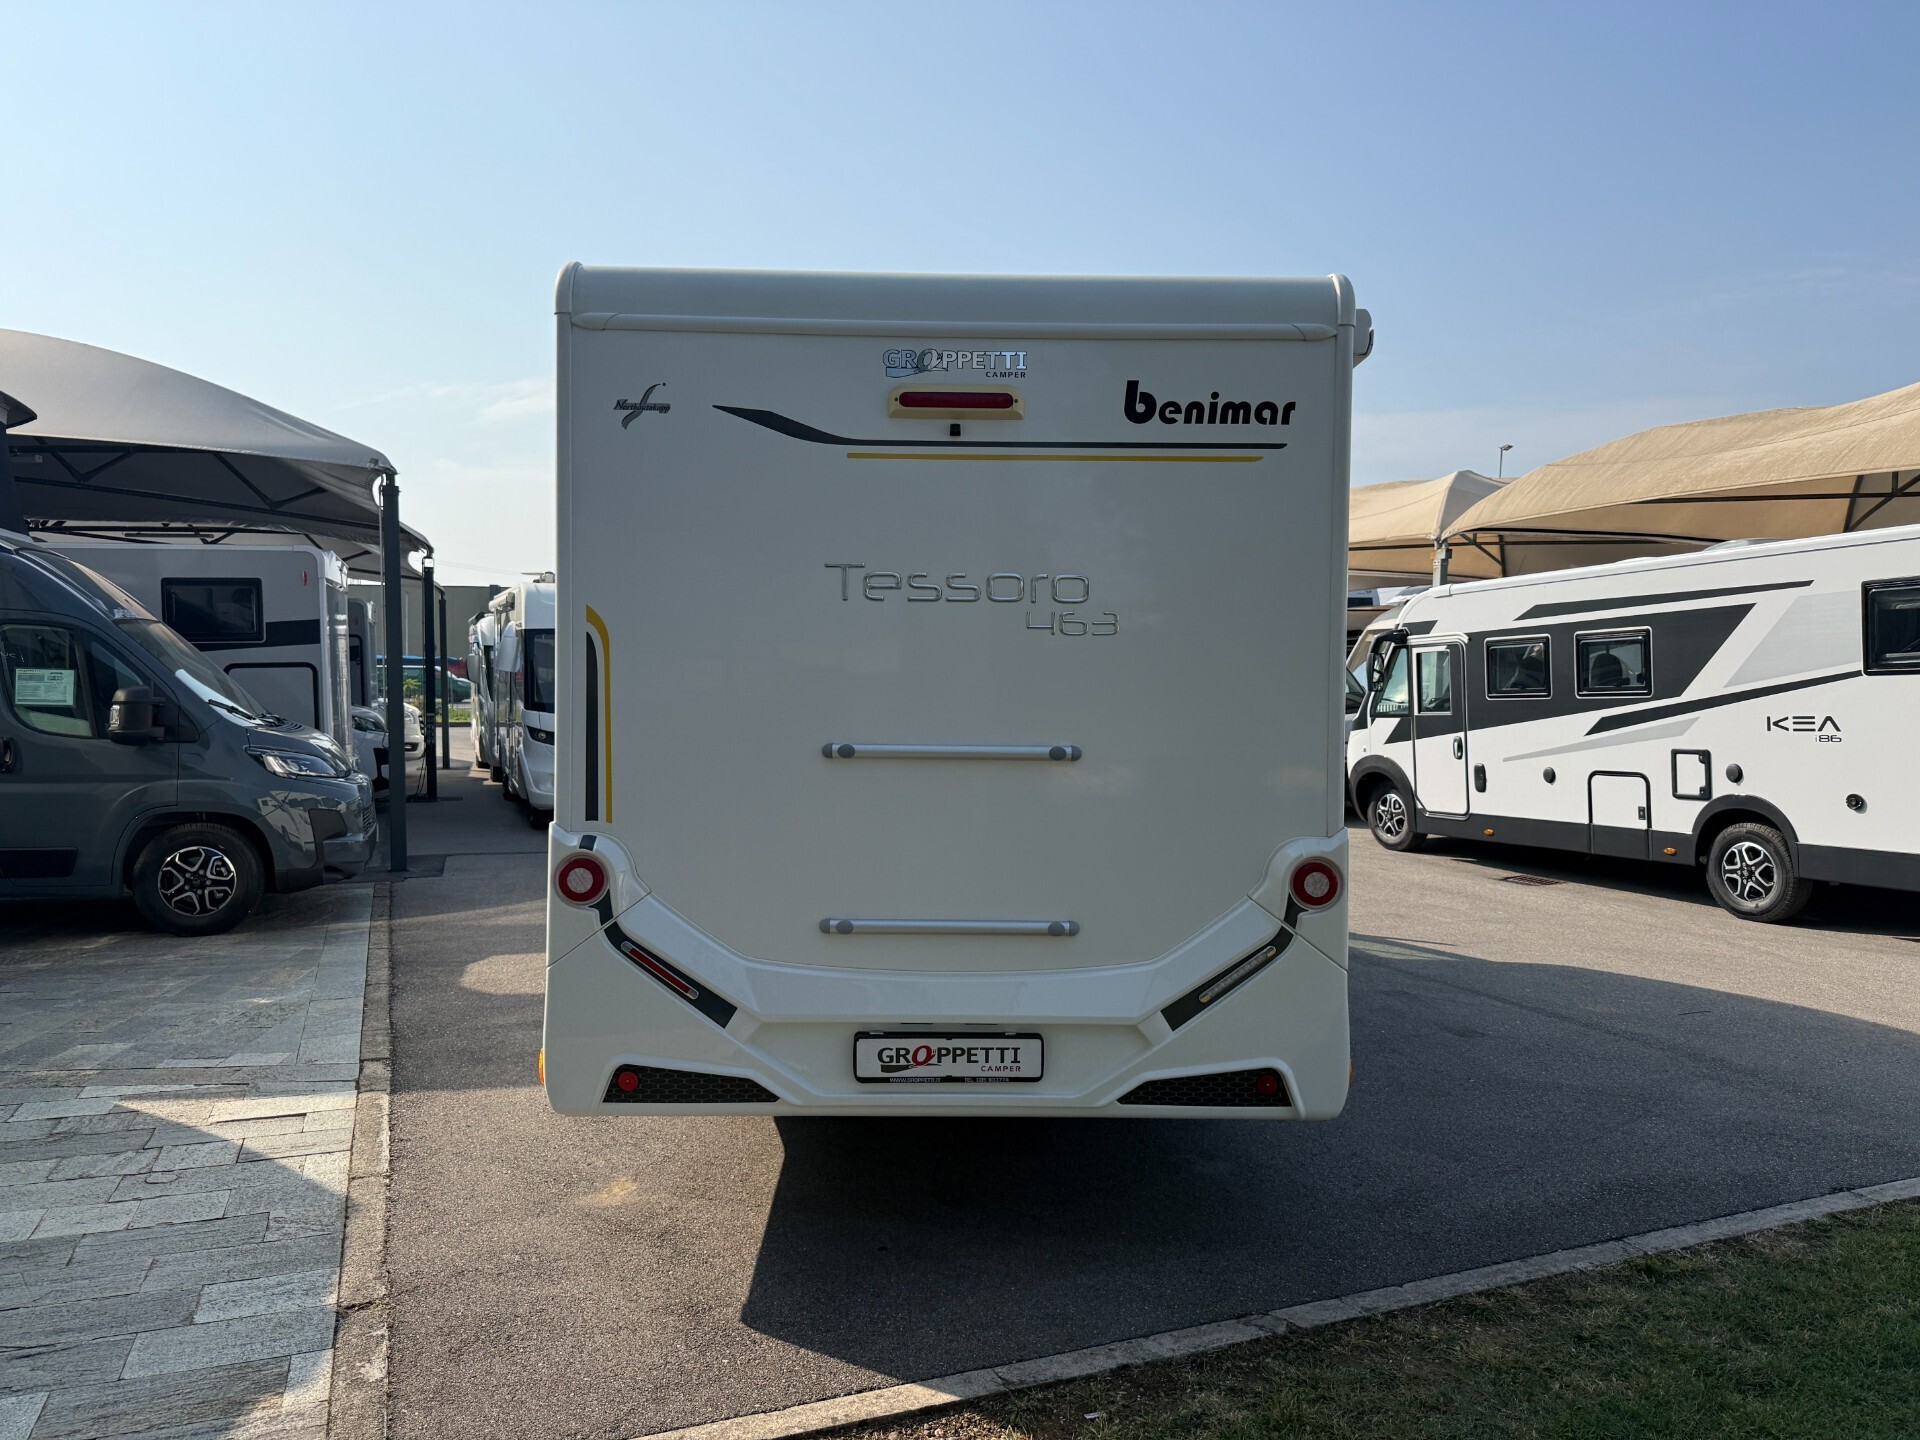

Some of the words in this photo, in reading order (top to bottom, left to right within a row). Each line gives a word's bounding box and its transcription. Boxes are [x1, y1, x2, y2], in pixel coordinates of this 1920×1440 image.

[882, 348, 1028, 371] GROPPETTI
[985, 371, 1026, 379] CAMPER
[1124, 380, 1296, 425] benimar
[824, 562, 1090, 603] Tessoro
[1026, 611, 1120, 636] 463
[1766, 715, 1841, 732] KEA
[877, 1045, 1021, 1067] GROPPETTI
